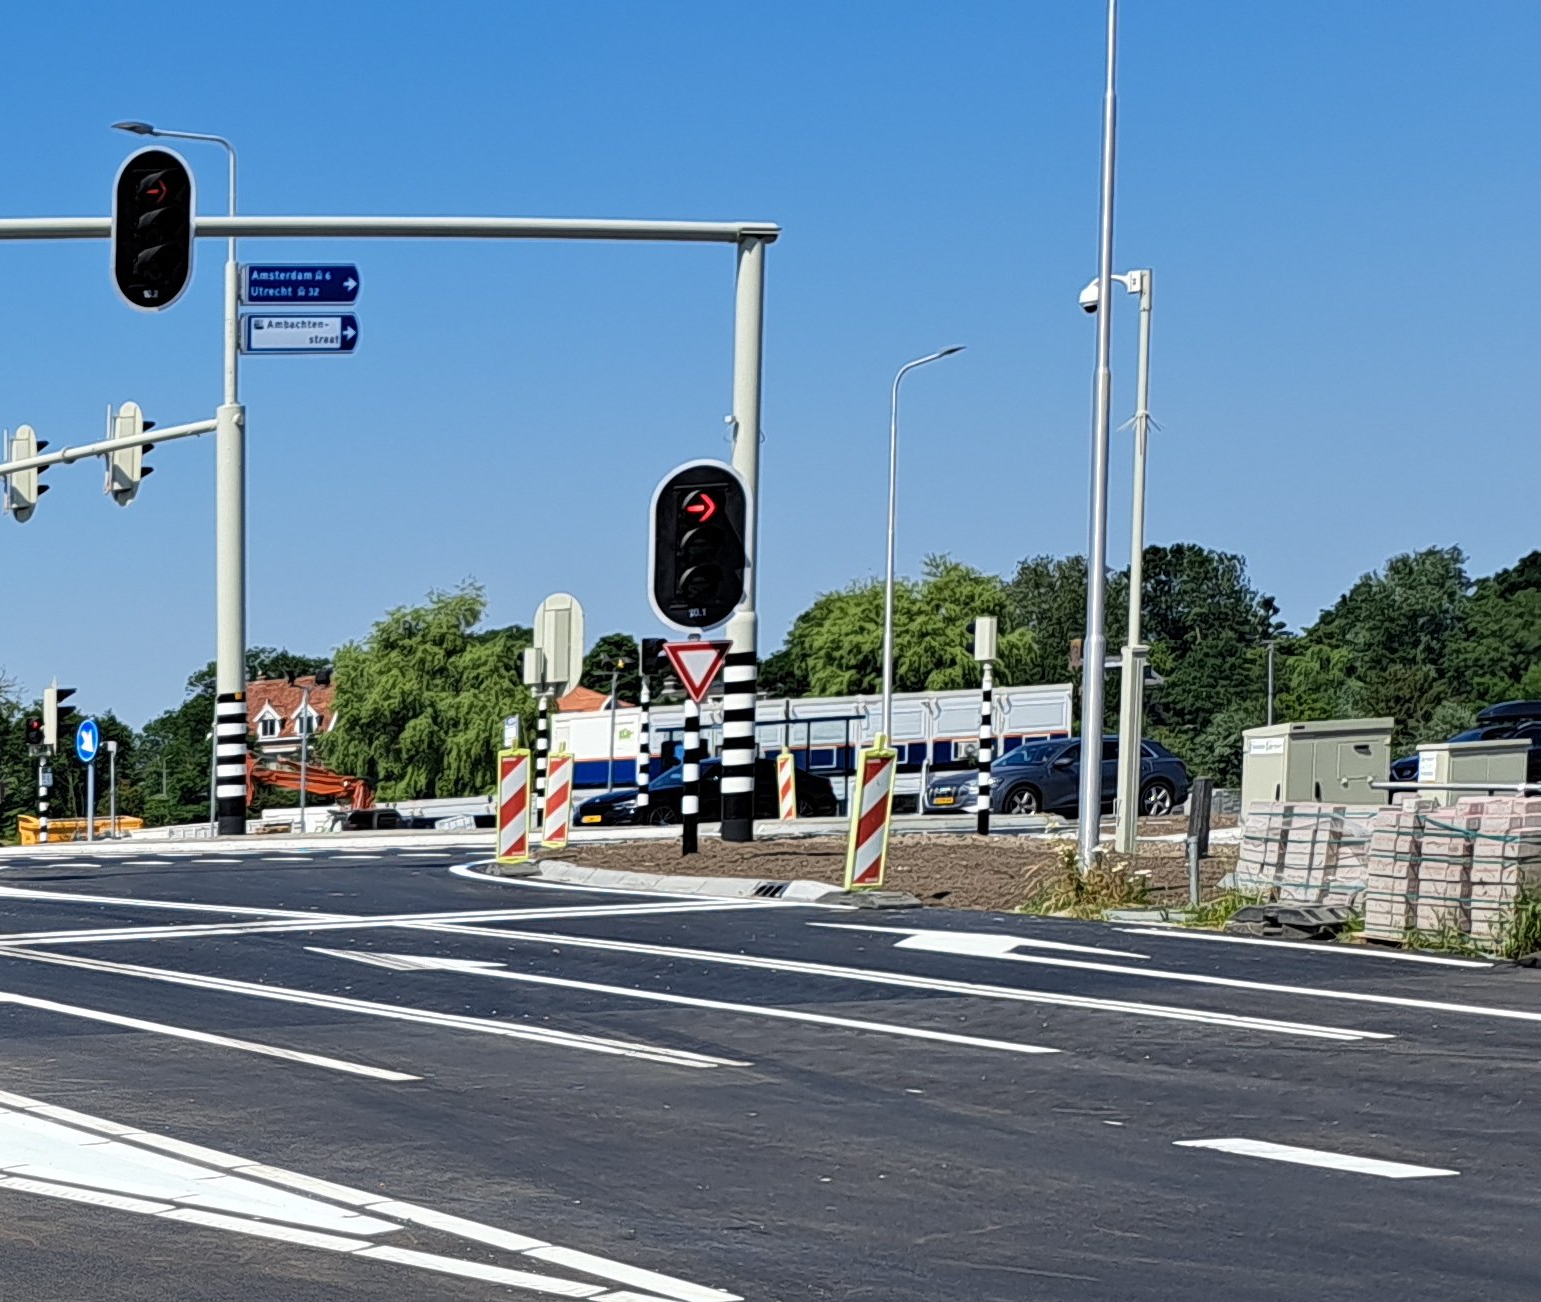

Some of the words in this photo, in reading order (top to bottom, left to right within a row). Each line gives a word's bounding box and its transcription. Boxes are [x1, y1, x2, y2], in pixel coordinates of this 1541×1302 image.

[251, 270, 313, 281] Amsterdam
[251, 286, 292, 297] Utrecht
[267, 319, 330, 329] Ambachten-
[309, 335, 339, 344] straat
